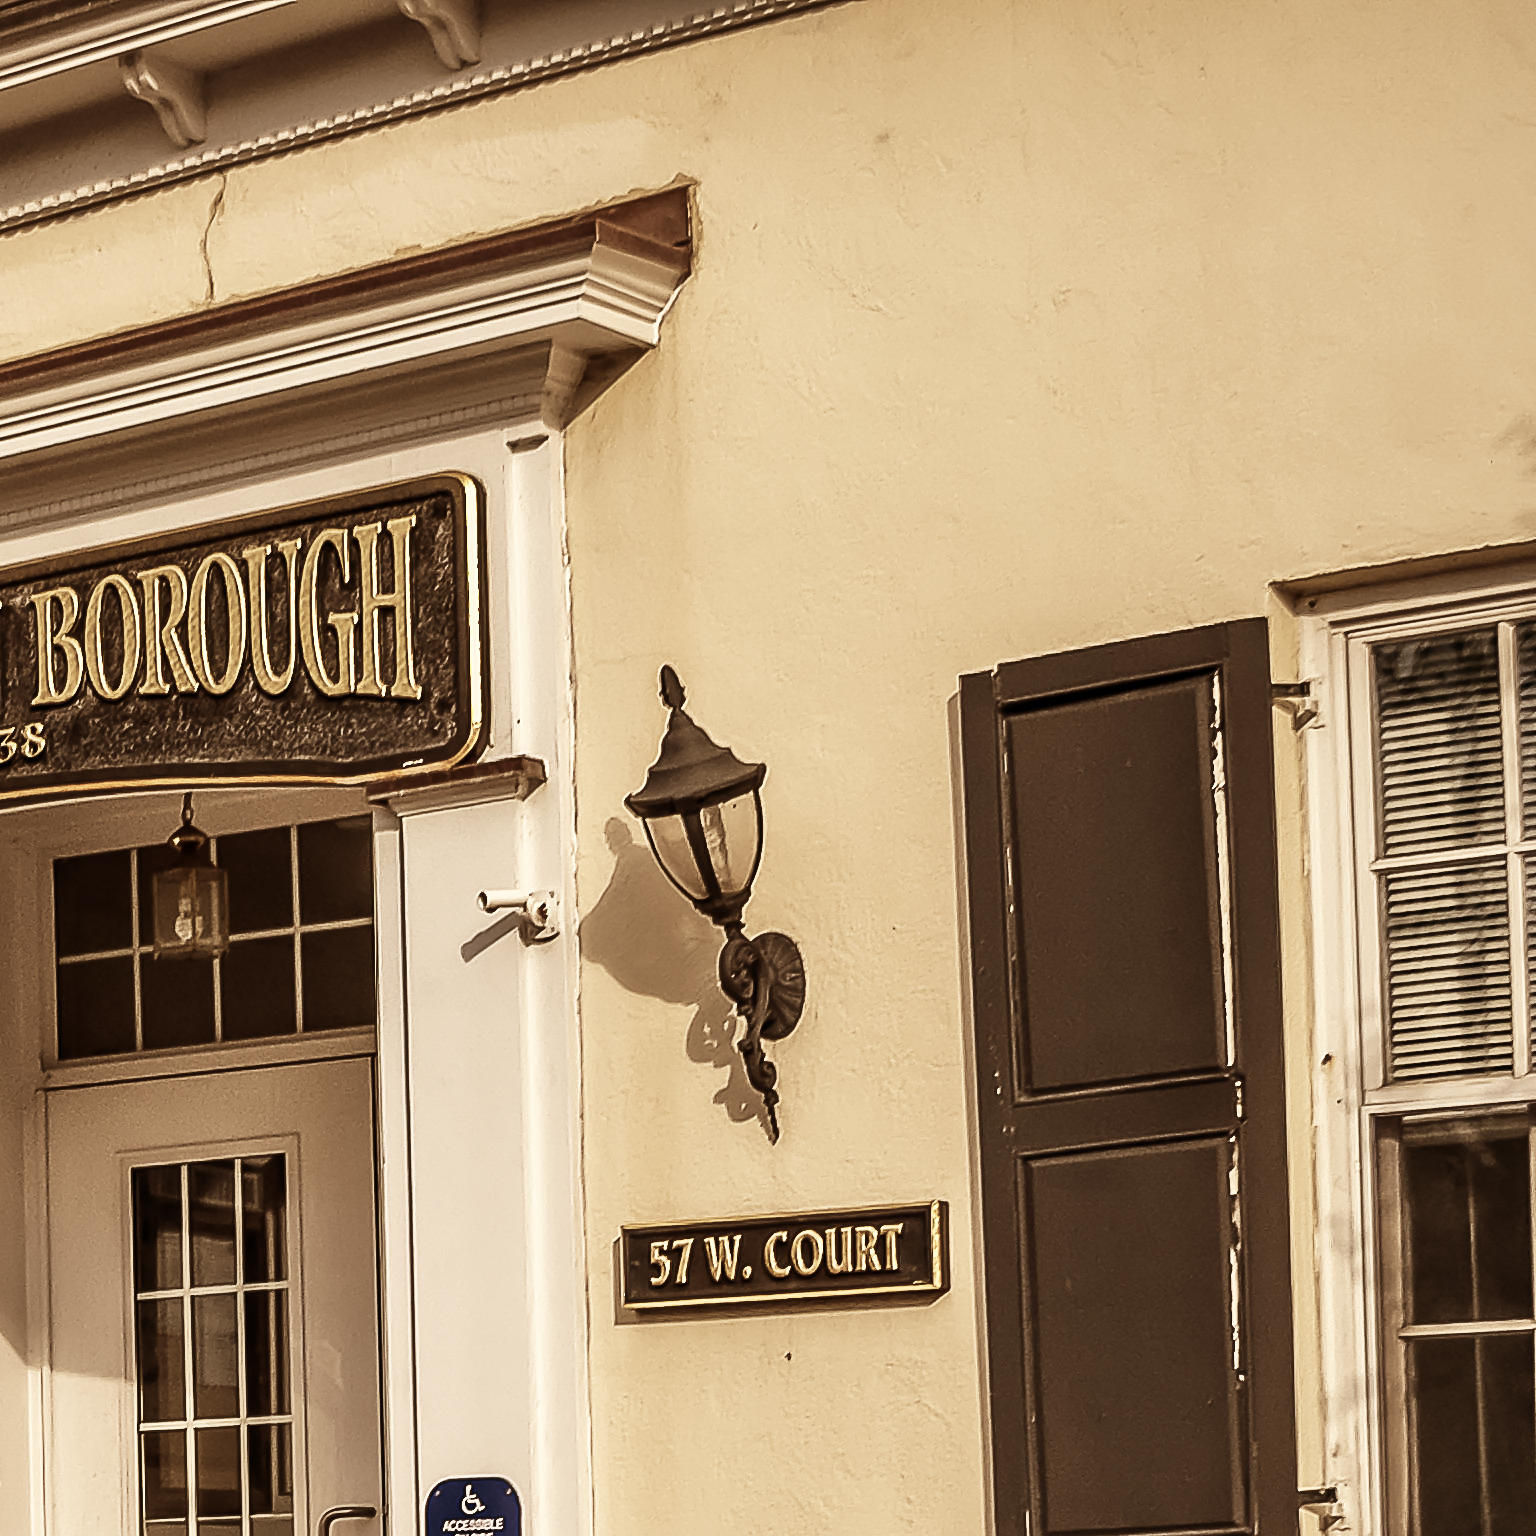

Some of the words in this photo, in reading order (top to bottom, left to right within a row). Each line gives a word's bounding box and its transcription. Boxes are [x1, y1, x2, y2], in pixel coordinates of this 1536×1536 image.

[29, 514, 423, 709] BOROUGH
[650, 1237, 695, 1287] 57
[703, 1233, 753, 1282] W.
[763, 1222, 904, 1279] COURT
[442, 1517, 504, 1532] ACCESSIBLE
